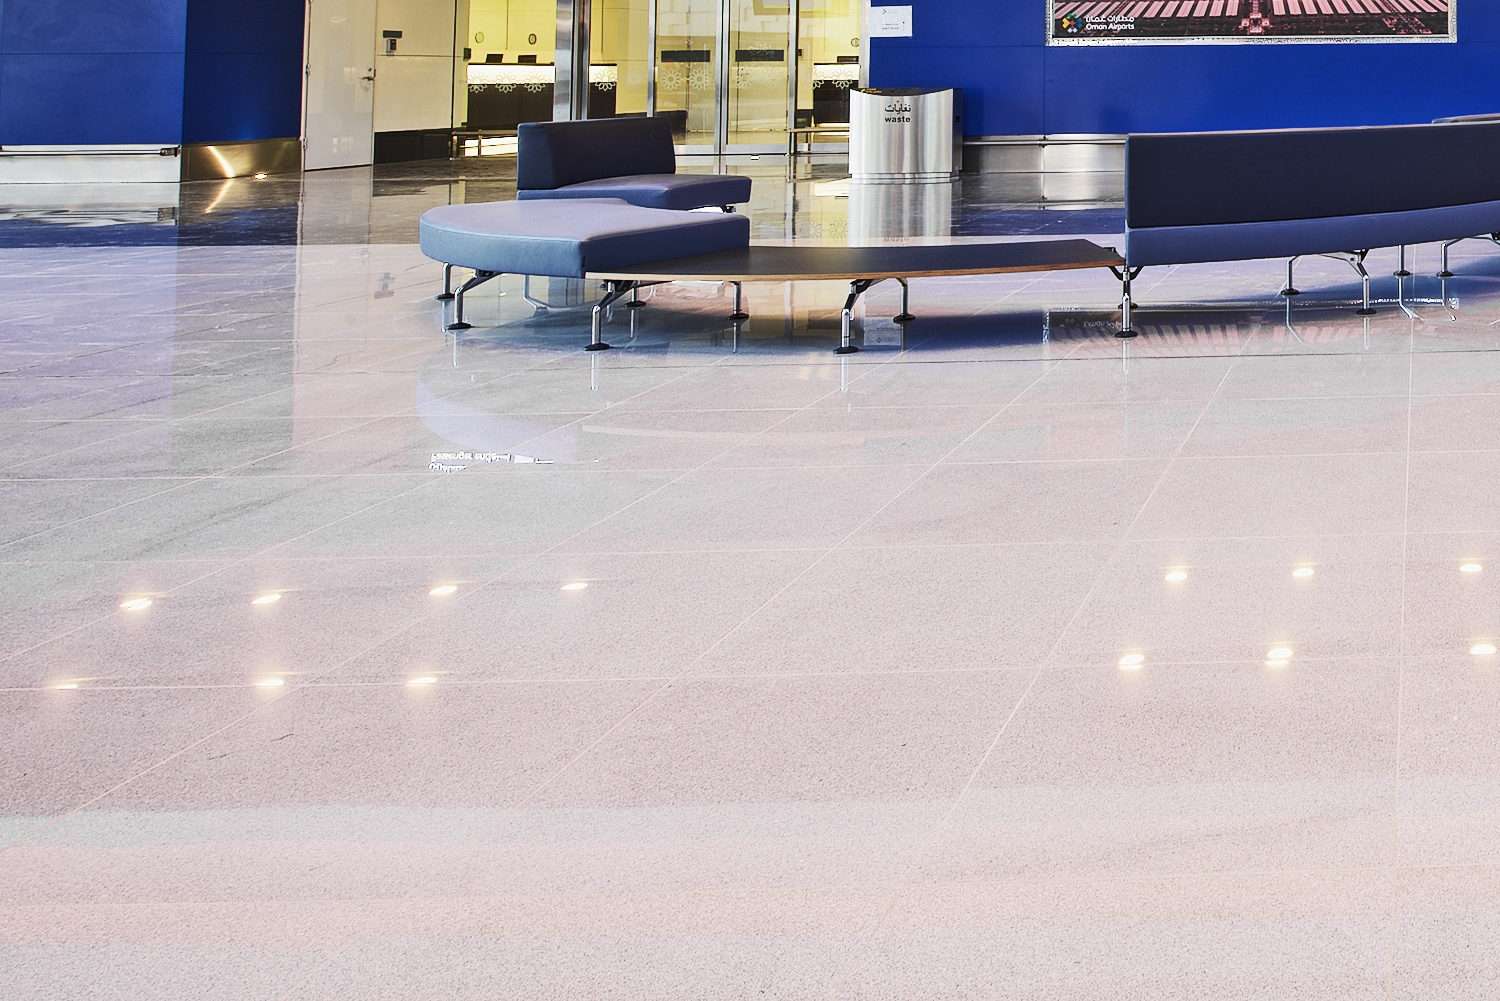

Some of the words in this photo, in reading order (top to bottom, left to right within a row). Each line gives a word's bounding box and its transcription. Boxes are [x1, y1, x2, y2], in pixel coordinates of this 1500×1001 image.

[1085, 23, 1107, 31] Oman
[1107, 23, 1135, 31] Airports
[884, 102, 912, 115] نفايات
[884, 115, 911, 123] waste
